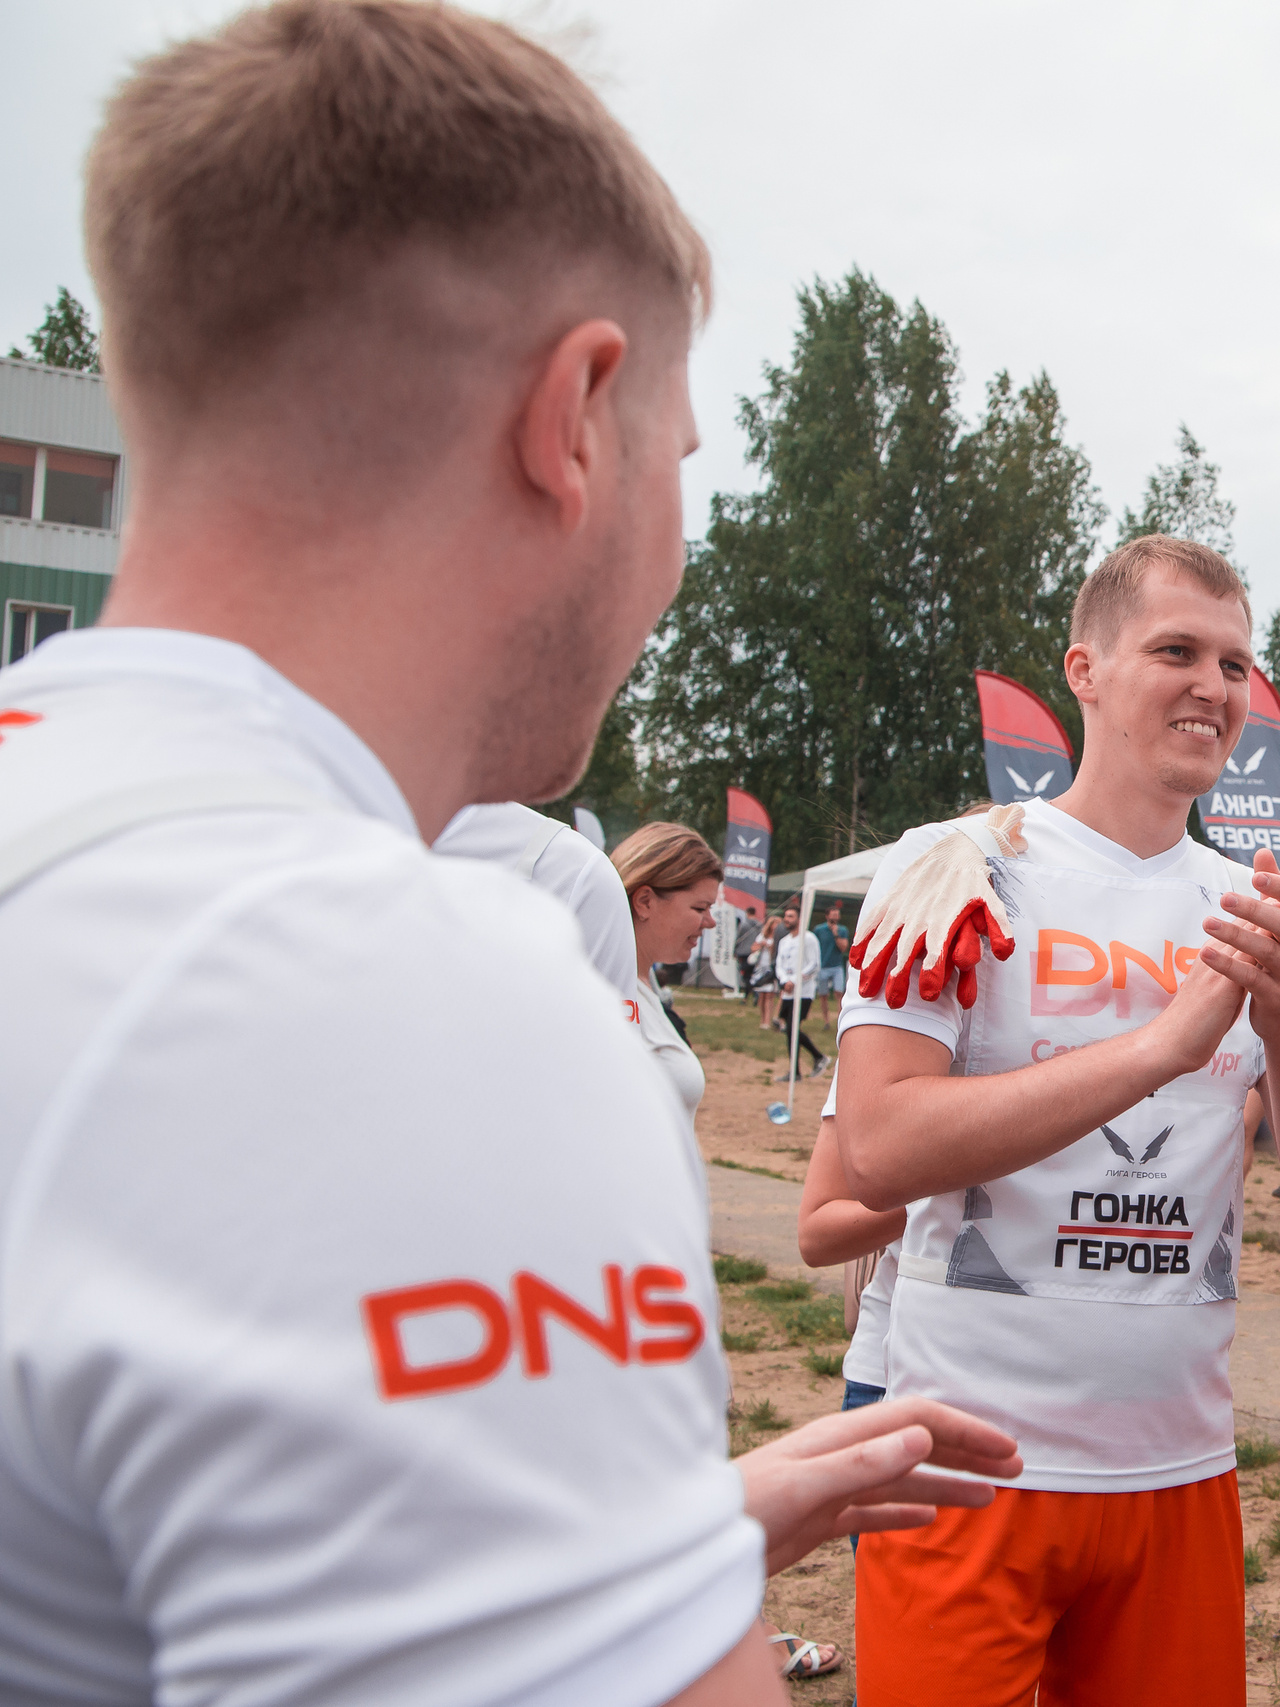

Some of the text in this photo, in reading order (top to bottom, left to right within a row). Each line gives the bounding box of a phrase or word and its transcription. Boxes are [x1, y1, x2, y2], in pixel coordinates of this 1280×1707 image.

[1105, 1169, 1168, 1179] ЛИГА ГЕРОЕВ
[1070, 1190, 1189, 1226] ГОНКА
[1054, 1238, 1191, 1275] ГЕРОЕВ
[360, 1262, 706, 1404] DNS
